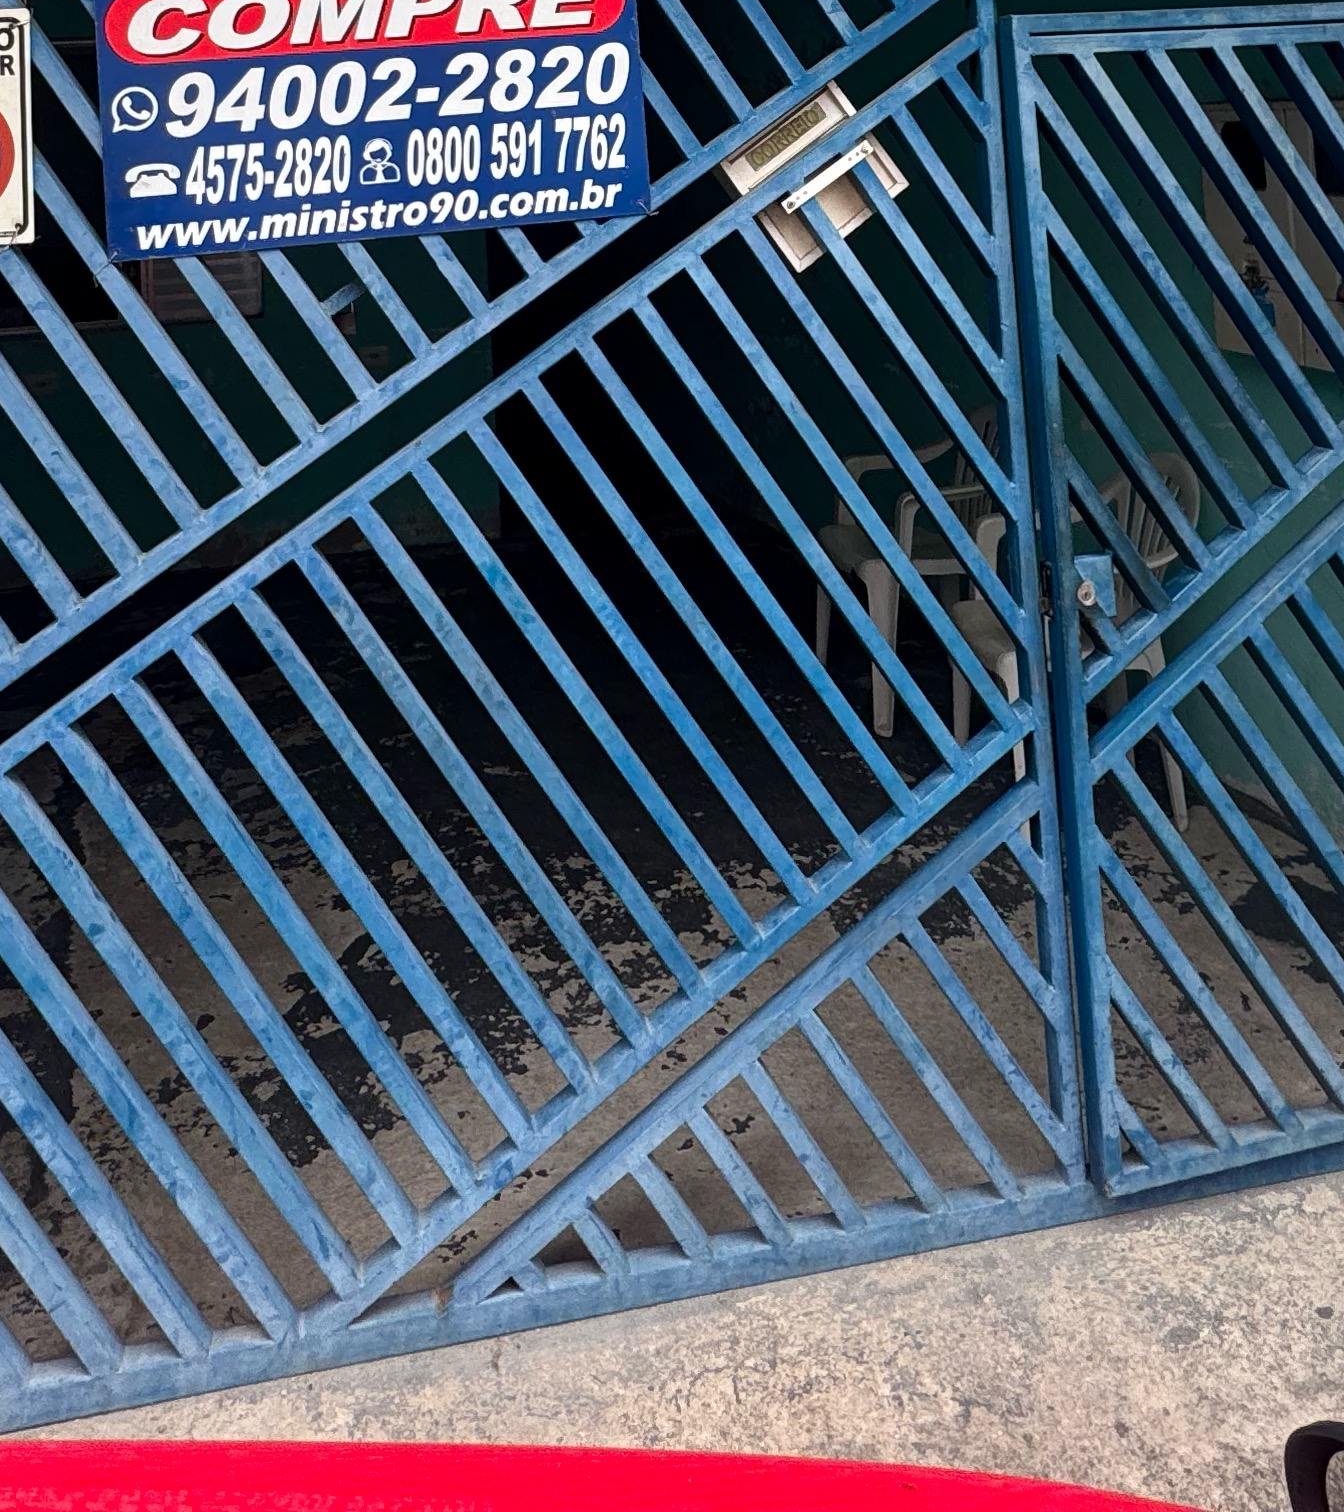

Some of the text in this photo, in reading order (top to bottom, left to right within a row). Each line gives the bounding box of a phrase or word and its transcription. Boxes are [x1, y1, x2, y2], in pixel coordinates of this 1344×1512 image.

[165, 43, 630, 138] 94002-2820
[186, 113, 626, 205] 4575-2820 0800 591 7762
[748, 106, 823, 168] CORREIO
[137, 178, 623, 251] www.ministro90.com.br
